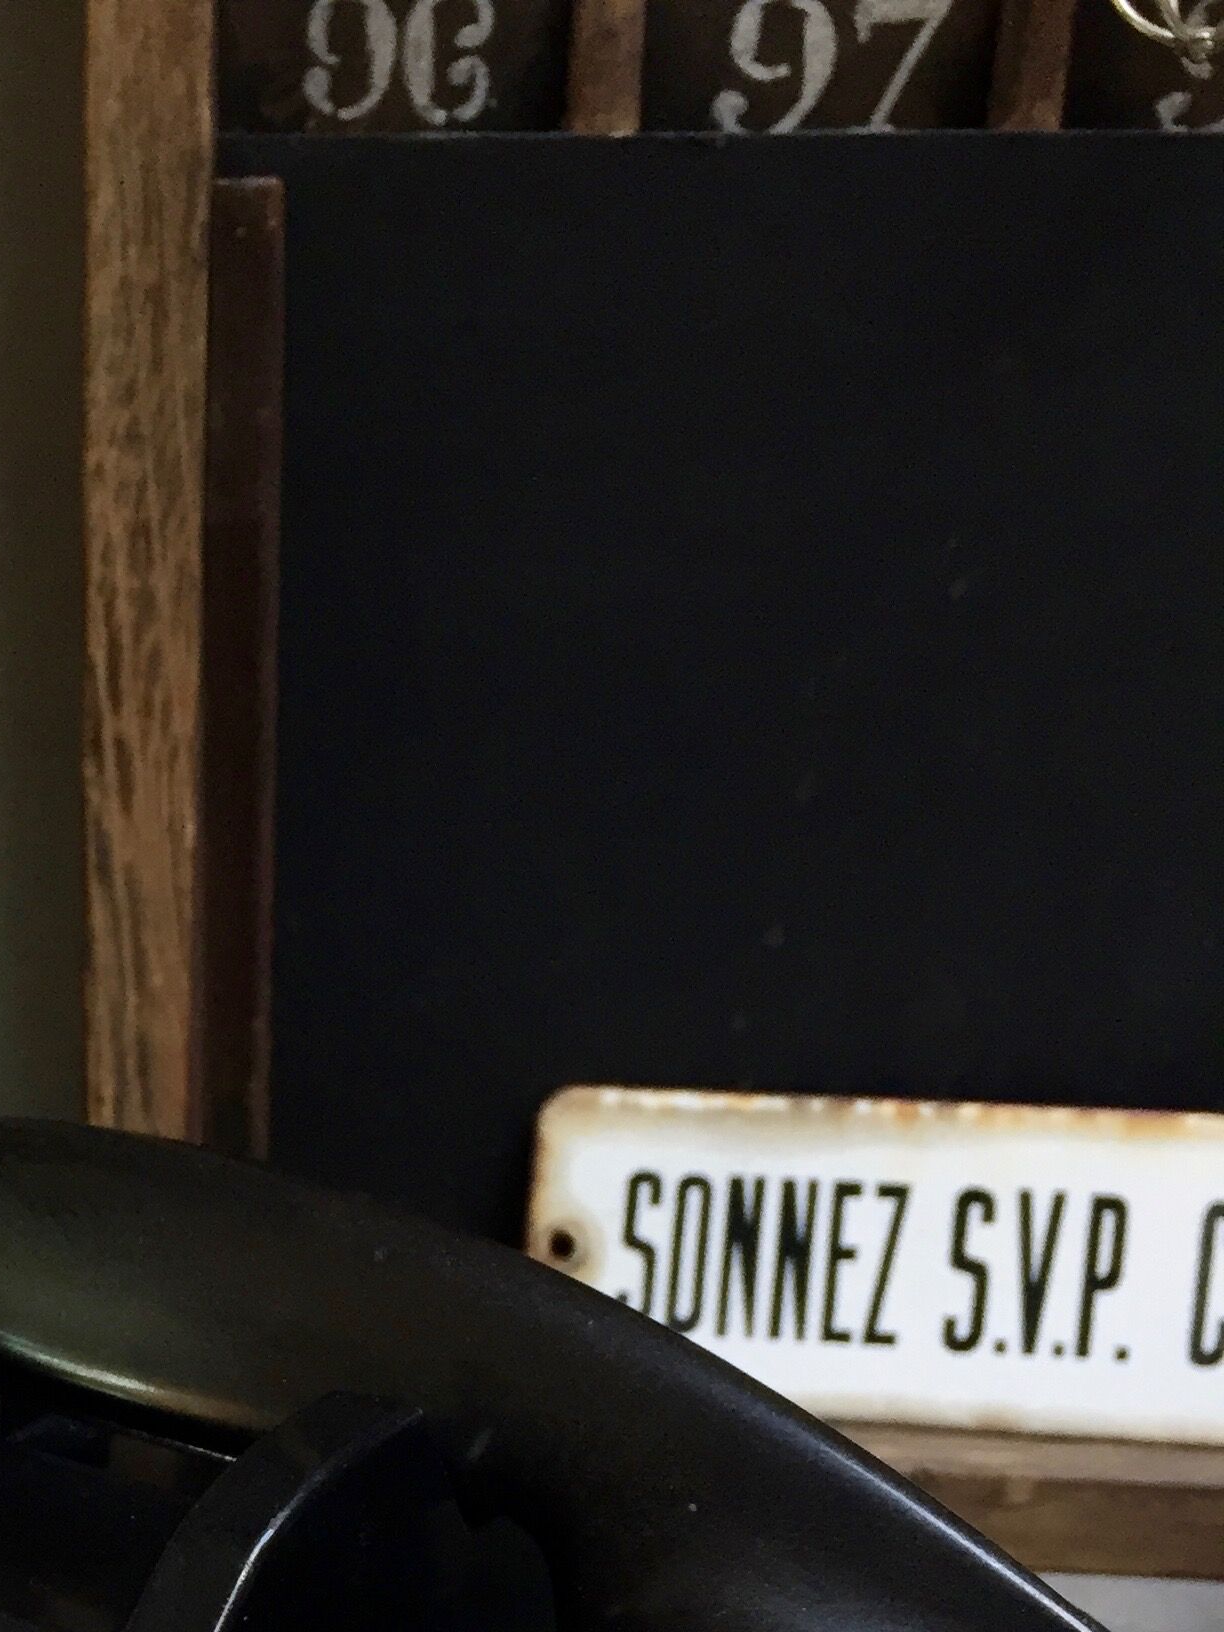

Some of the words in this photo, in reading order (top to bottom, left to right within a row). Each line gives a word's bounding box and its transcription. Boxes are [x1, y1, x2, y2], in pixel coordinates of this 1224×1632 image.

[303, 0, 495, 126] 96
[712, 0, 952, 134] 97
[618, 1171, 909, 1345] SONNEZ
[943, 1188, 1128, 1361] S.V.P.
